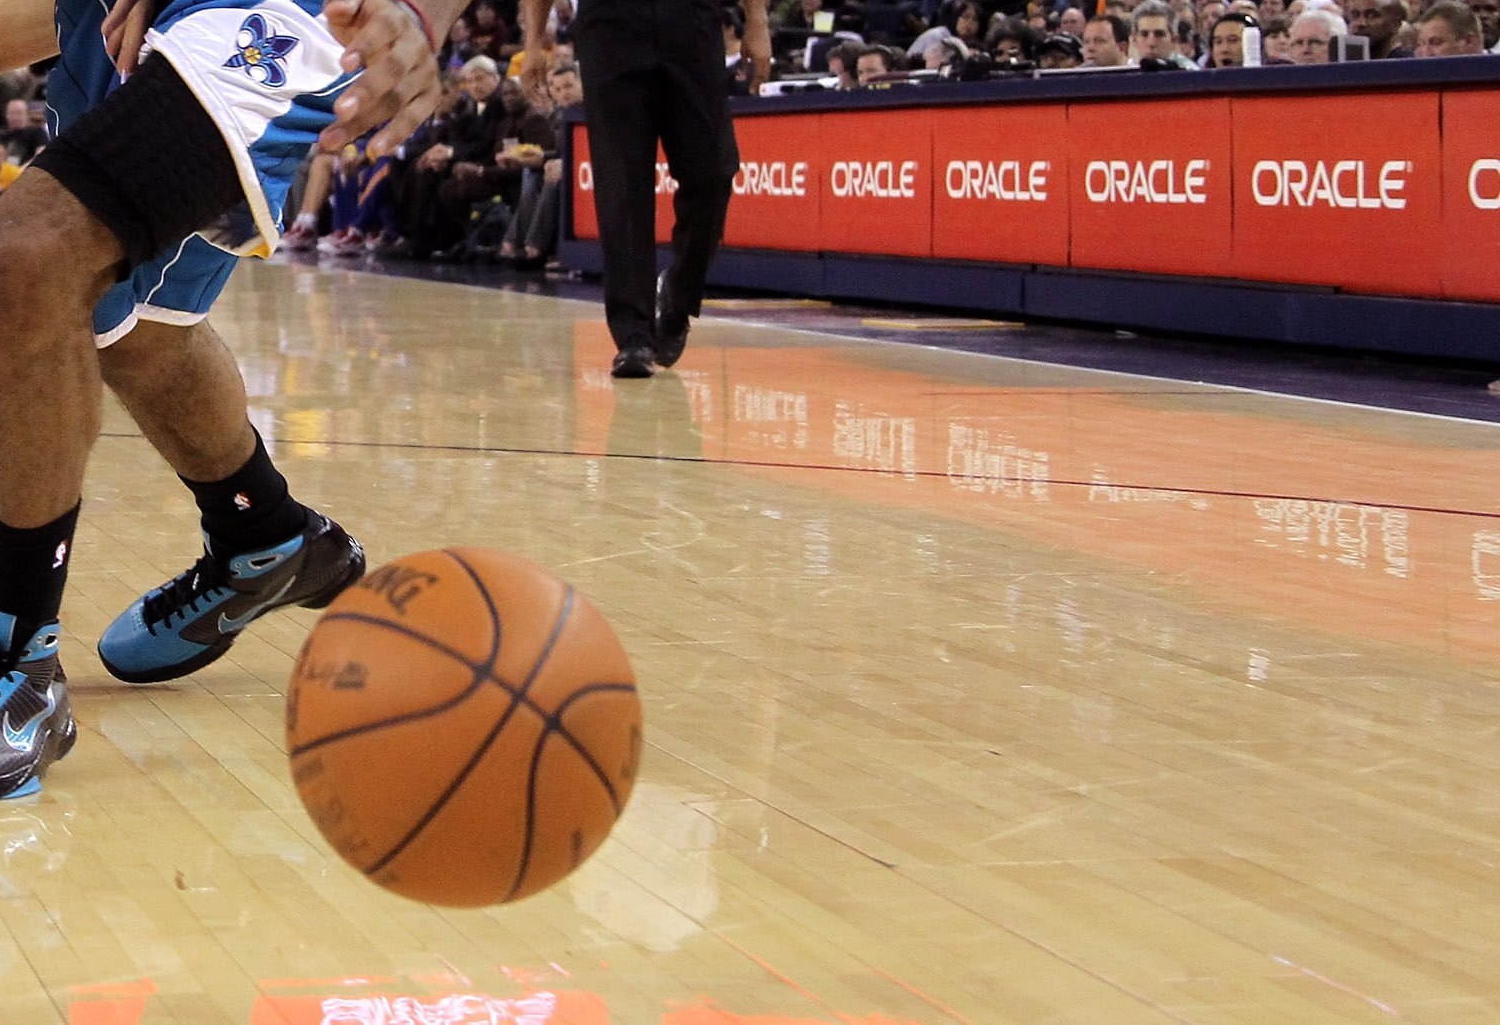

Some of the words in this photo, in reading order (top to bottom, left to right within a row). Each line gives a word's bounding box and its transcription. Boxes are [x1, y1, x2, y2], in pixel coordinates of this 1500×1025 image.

[732, 162, 806, 196] ORACLE
[831, 161, 916, 198] ORACLE
[946, 160, 1048, 202] ORACLE
[1085, 159, 1208, 204] ORACLE
[1251, 160, 1407, 210] ORACLE
